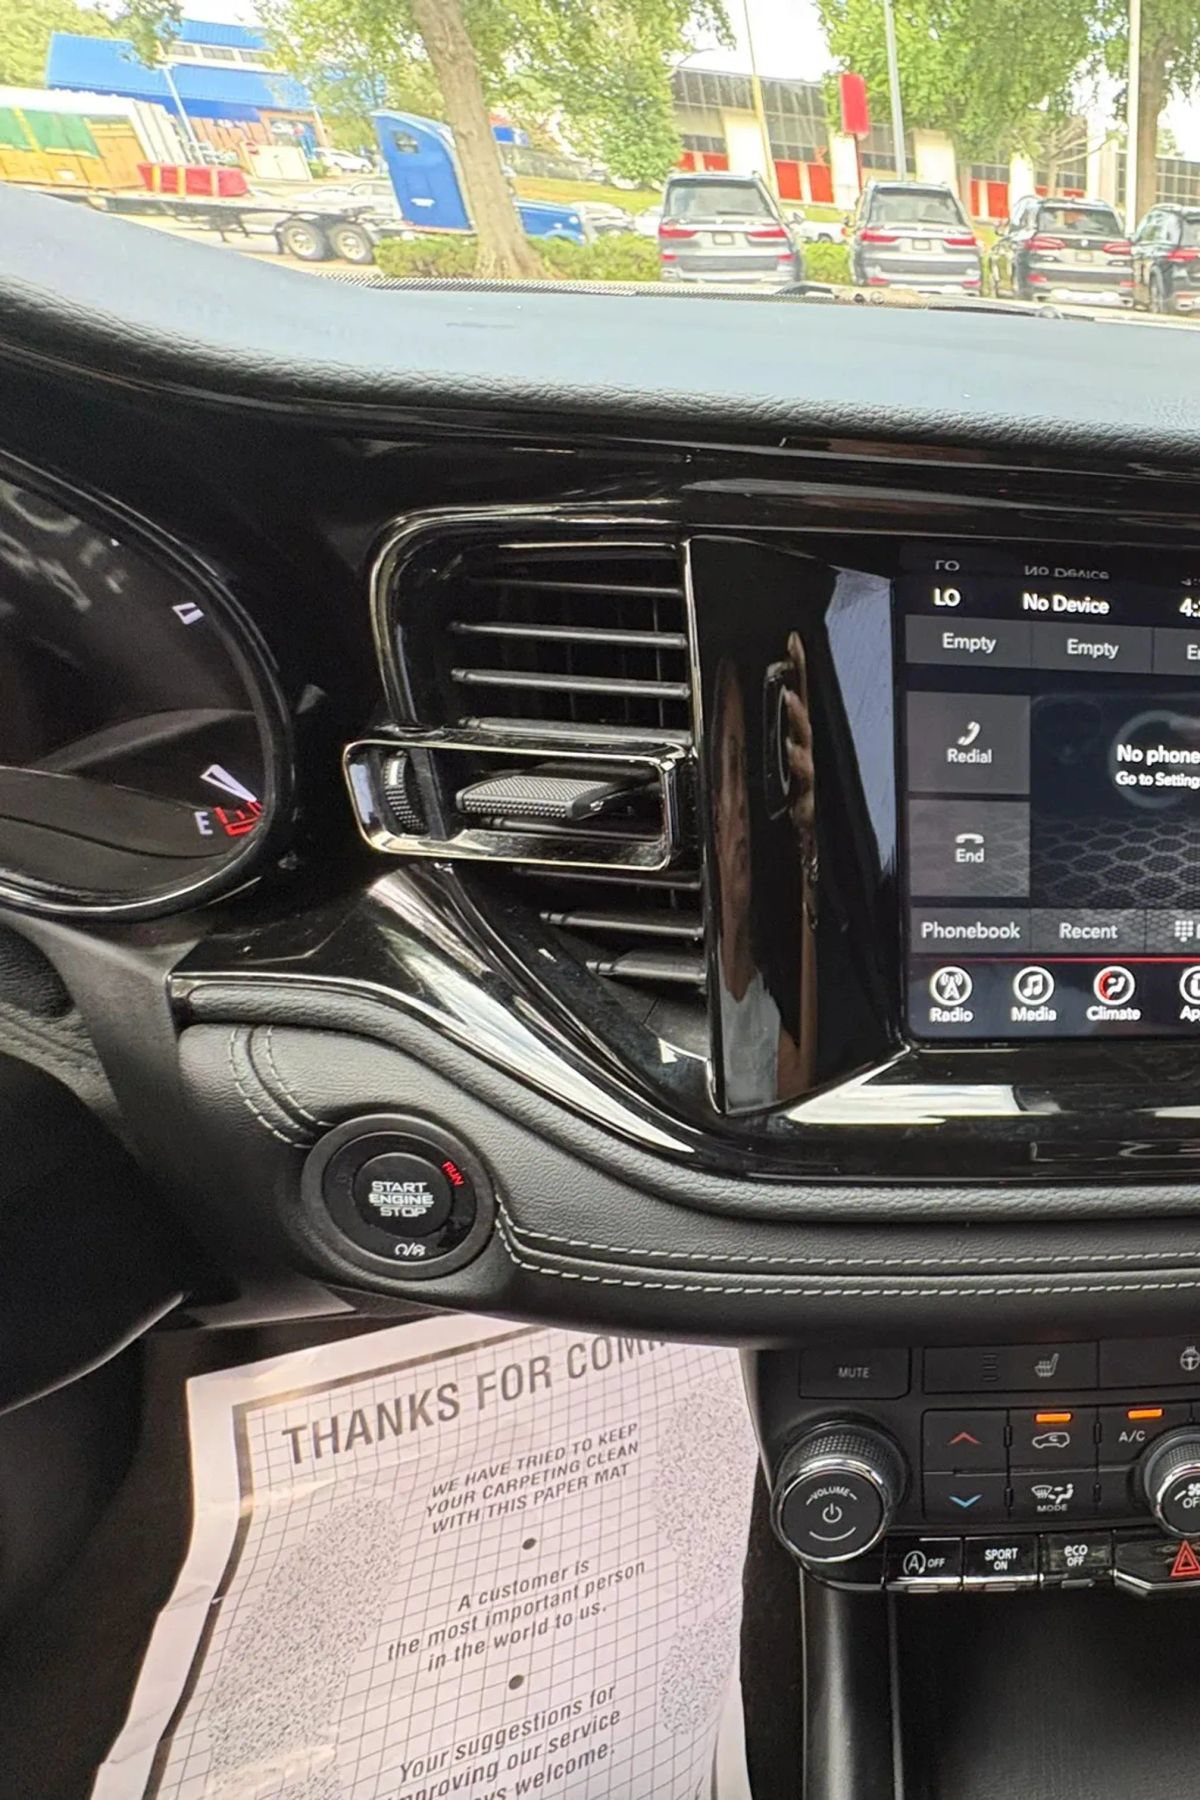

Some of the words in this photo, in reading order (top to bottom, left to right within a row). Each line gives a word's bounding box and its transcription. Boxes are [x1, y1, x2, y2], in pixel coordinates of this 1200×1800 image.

[933, 588, 961, 607] LO
[1023, 593, 1049, 611] No
[1052, 594, 1110, 615] Device
[942, 632, 997, 655] Empty
[1067, 638, 1119, 660] Empty
[947, 748, 992, 763] Redial
[1117, 744, 1143, 762] No
[1146, 745, 1200, 765] phone
[1115, 771, 1137, 785] Go
[1138, 773, 1154, 786] to
[194, 811, 213, 835] E
[956, 848, 985, 863] End
[921, 922, 1021, 940] Phonebook
[1059, 922, 1118, 940] Recent
[930, 1007, 974, 1023] Radio
[1011, 1006, 1057, 1022] Media
[1086, 1006, 1141, 1022] Climate
[442, 1161, 464, 1186] RUN
[372, 1181, 427, 1193] START
[368, 1193, 434, 1205] ENGINE
[380, 1206, 427, 1217] STOP
[838, 1368, 870, 1379] MUTE
[281, 1382, 460, 1465] THANKS
[477, 1355, 552, 1410] FOR
[1119, 1431, 1146, 1443] A/C
[432, 1477, 459, 1498] WE
[464, 1462, 511, 1486] HAVE
[516, 1447, 566, 1470] TRIED
[572, 1438, 593, 1454] TO
[598, 1423, 638, 1447] KEEP
[426, 1490, 476, 1518] YOUR
[482, 1460, 580, 1500] CARPETING
[586, 1441, 639, 1469] CLEAN
[432, 1507, 480, 1535] WITH
[488, 1494, 528, 1518] THIS
[533, 1475, 588, 1505] PAPER
[594, 1462, 631, 1485] MAT
[811, 1487, 850, 1500] VOLUME
[1037, 1504, 1068, 1512] MODE
[985, 1548, 1018, 1561] SPORT
[1064, 1544, 1088, 1557] eco
[927, 1558, 945, 1569] OFF
[994, 1560, 1008, 1571] ON
[1067, 1556, 1084, 1567] OFF
[458, 1595, 471, 1612] A
[478, 1566, 569, 1606] customer
[575, 1559, 590, 1576] is
[387, 1637, 420, 1662] the
[428, 1615, 478, 1647] most
[485, 1585, 580, 1627] important
[585, 1561, 646, 1600] person
[428, 1653, 447, 1672] in
[454, 1639, 486, 1662] the
[494, 1617, 549, 1649] world
[555, 1612, 573, 1629] to
[579, 1601, 607, 1620] us.
[400, 1750, 450, 1783] Your
[455, 1699, 582, 1761] suggestions
[589, 1685, 616, 1708] for
[507, 1744, 543, 1771] our
[548, 1710, 621, 1754] service
[514, 1742, 616, 1796] welcome.
